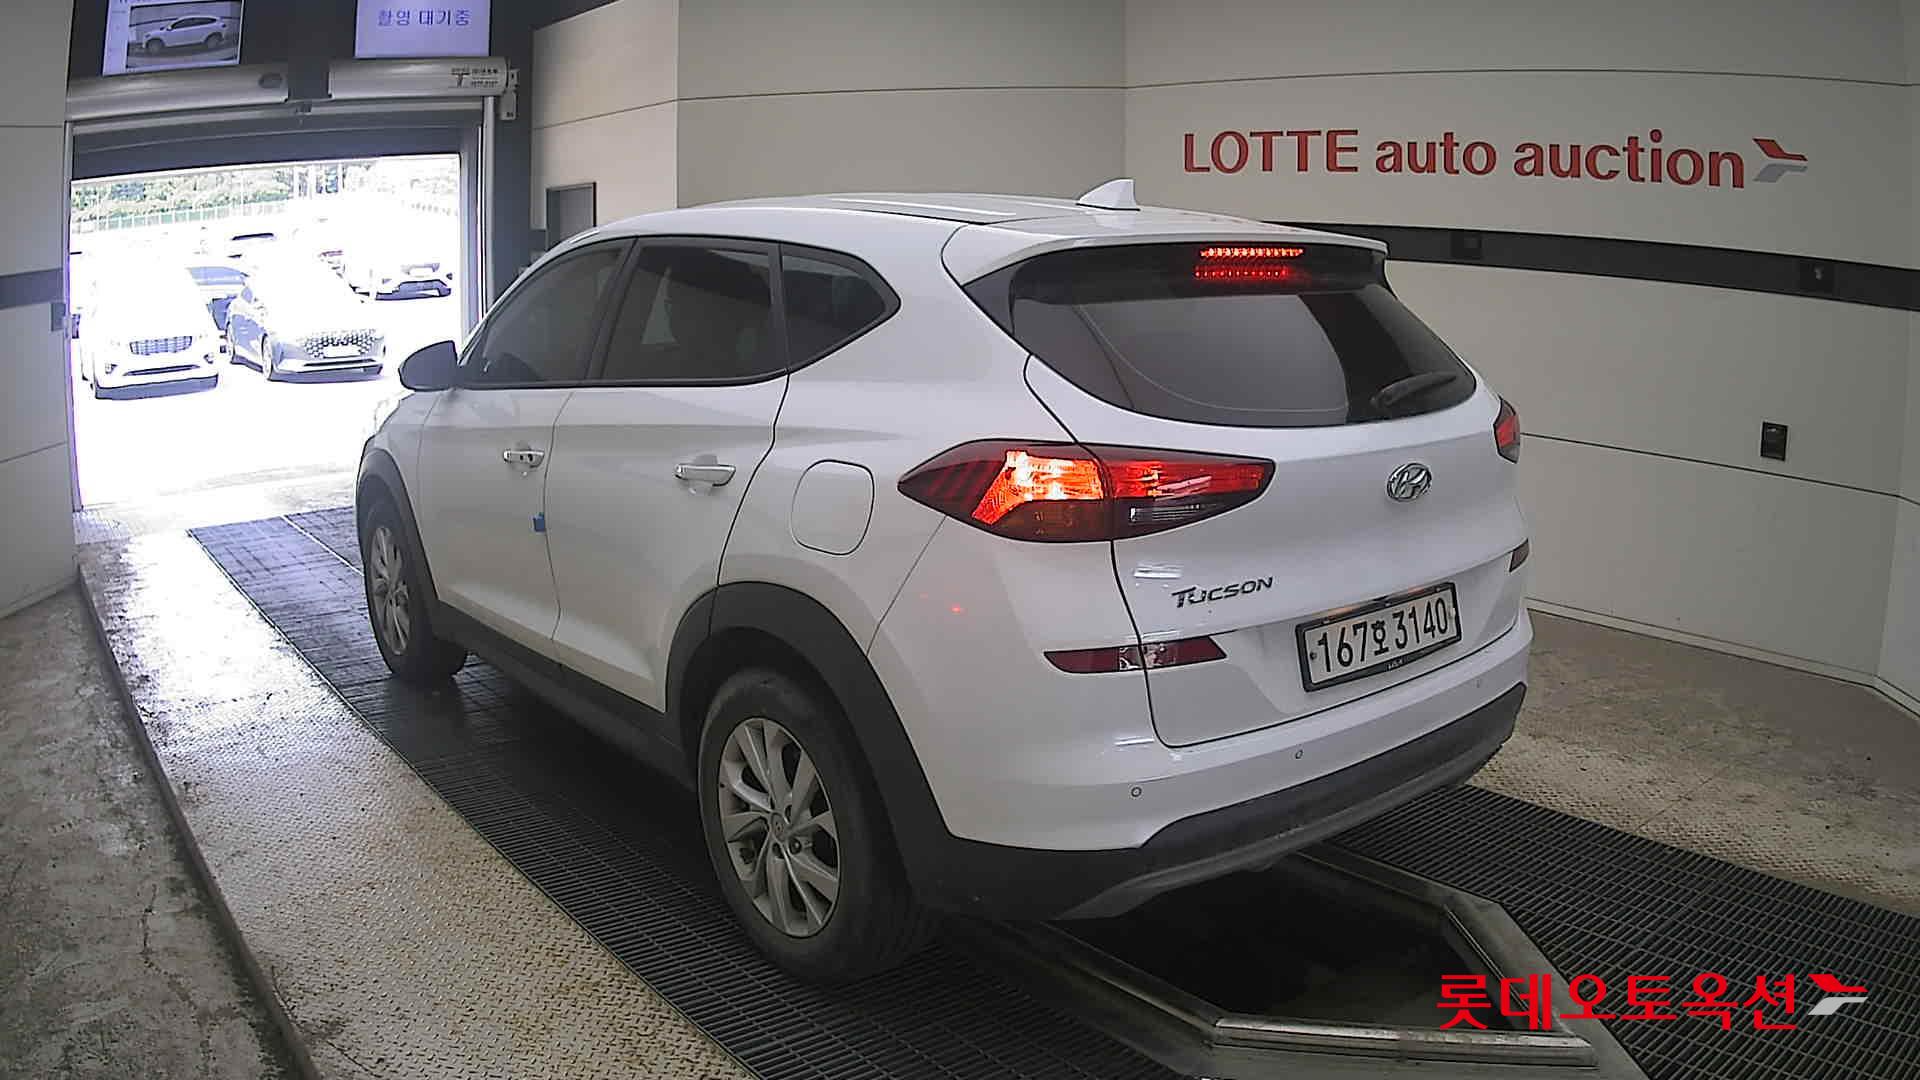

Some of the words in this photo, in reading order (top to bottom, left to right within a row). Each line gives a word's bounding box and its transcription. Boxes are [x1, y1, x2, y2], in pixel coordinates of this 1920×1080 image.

[419, 8, 471, 26] 대기중
[1184, 130, 1358, 173] LOTTE
[1376, 132, 1497, 175] auto
[1514, 129, 1744, 188] auction
[1171, 575, 1274, 608] TUCSON
